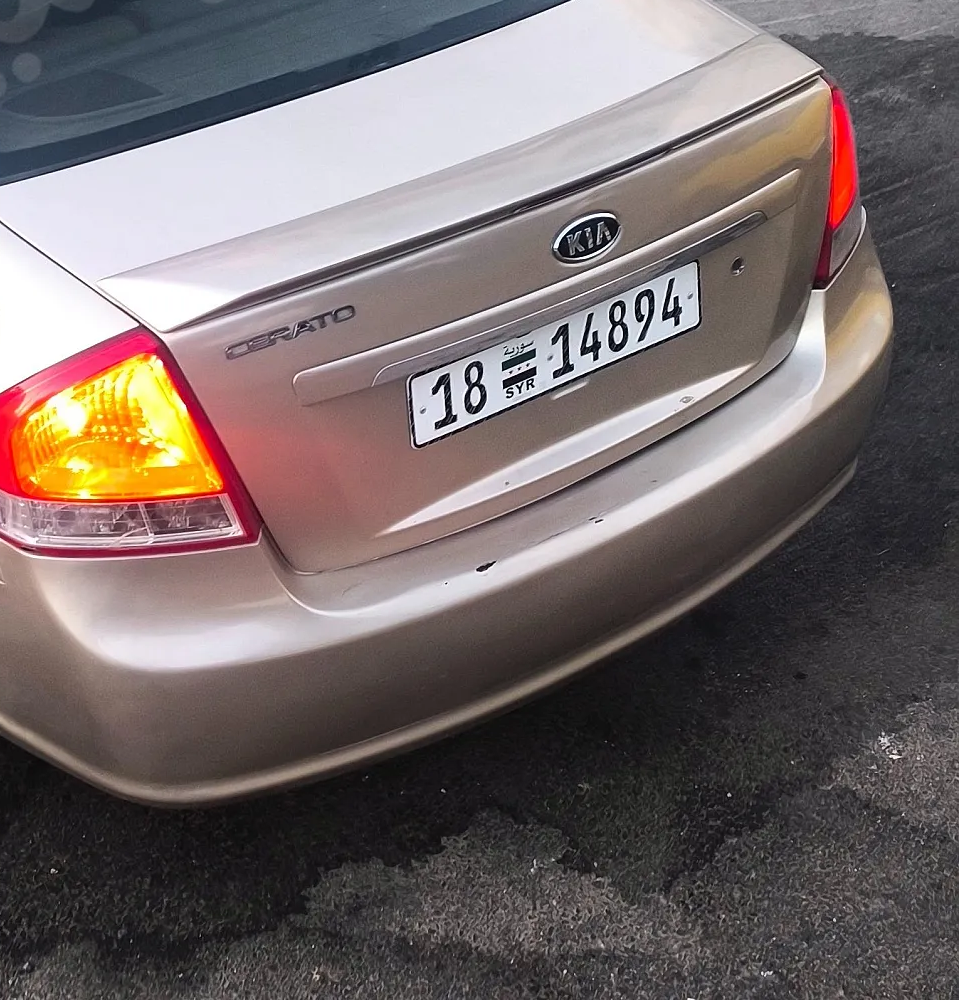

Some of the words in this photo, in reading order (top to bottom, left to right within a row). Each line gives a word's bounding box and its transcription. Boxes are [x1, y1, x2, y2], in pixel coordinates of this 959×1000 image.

[565, 220, 613, 256] KIA
[224, 304, 356, 360] CERATO
[502, 339, 535, 358] سورية
[431, 360, 488, 431] 18
[549, 276, 684, 380] 14894
[505, 378, 536, 399] SYR
